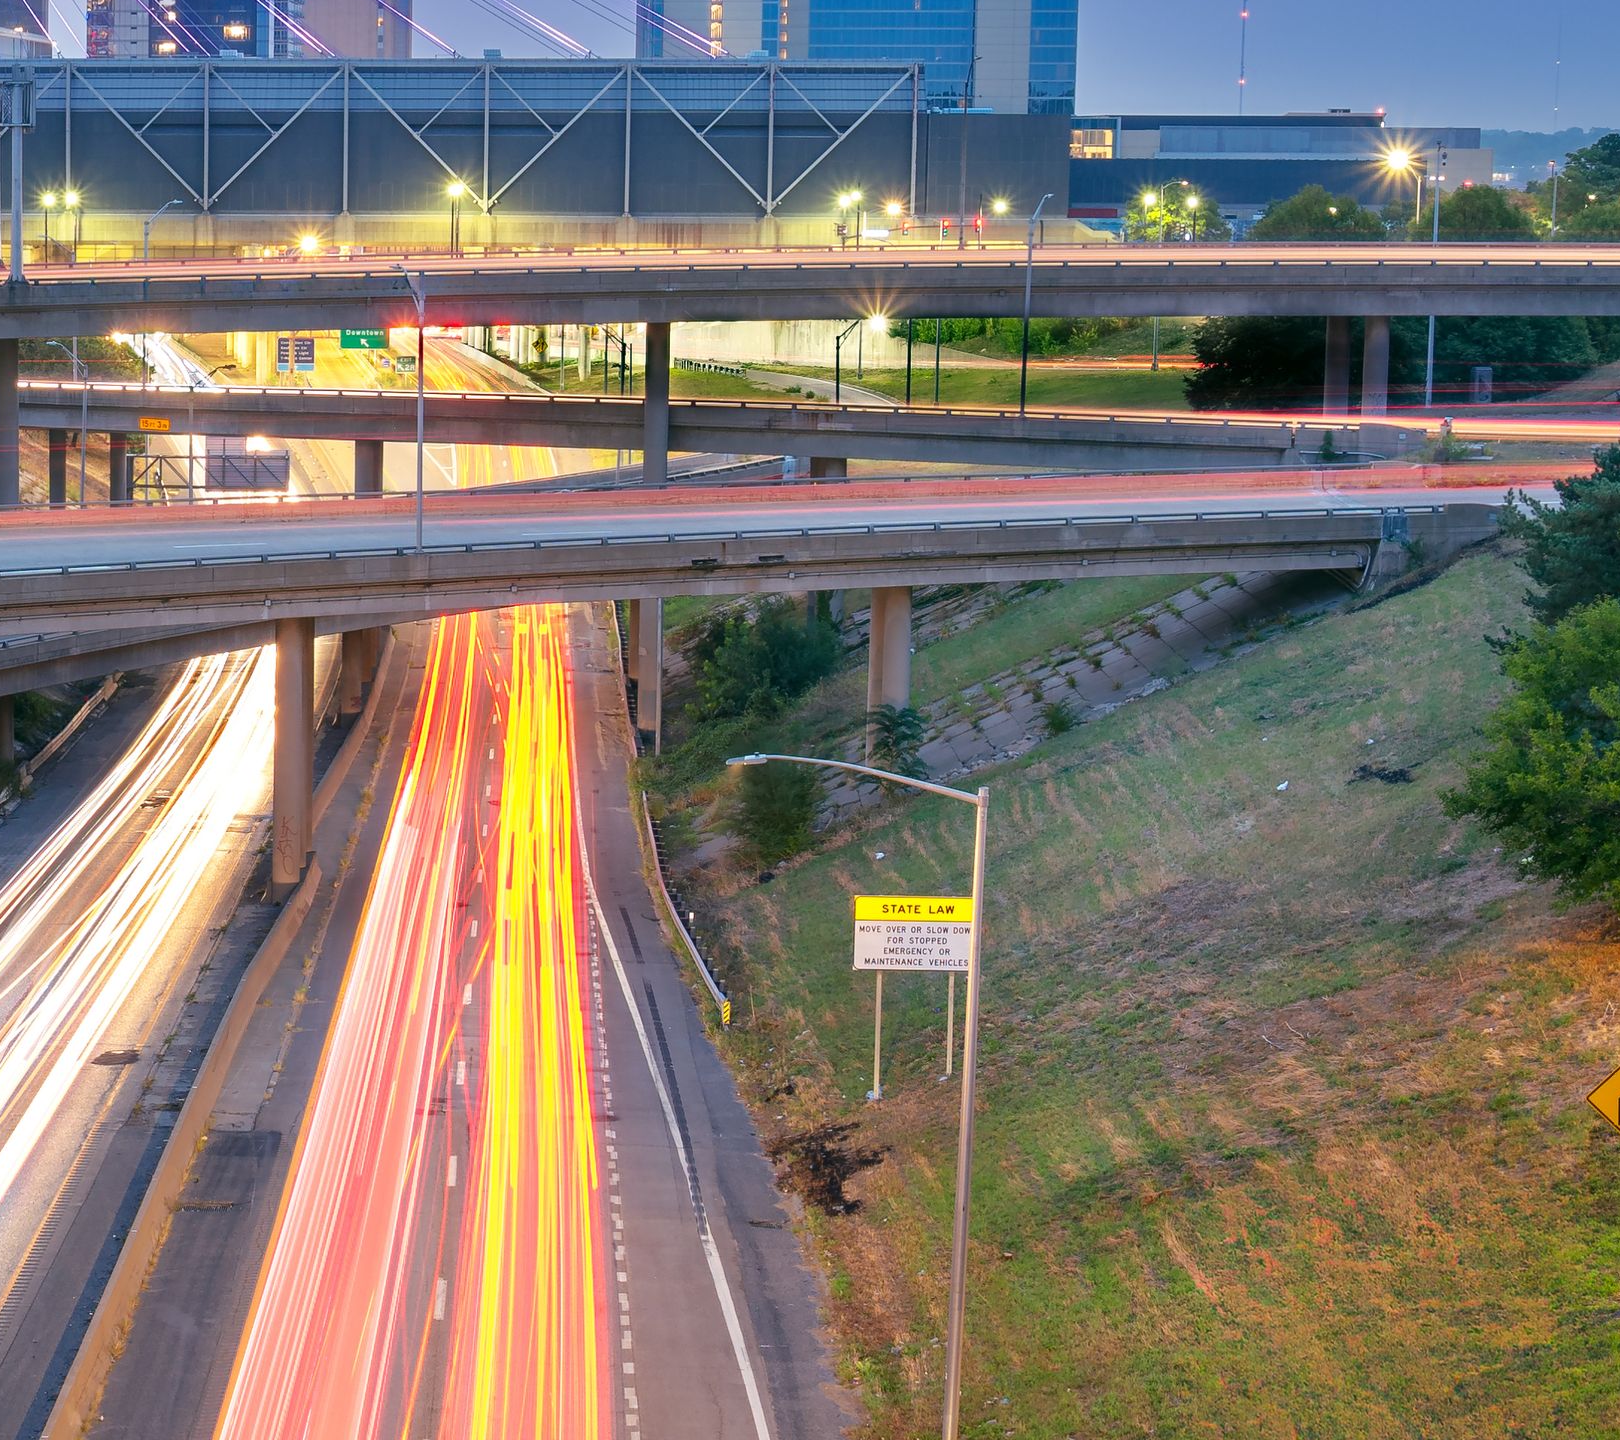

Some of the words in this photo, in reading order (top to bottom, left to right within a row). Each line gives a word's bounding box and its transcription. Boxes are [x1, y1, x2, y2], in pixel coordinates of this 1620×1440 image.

[142, 420, 149, 428] 15
[157, 421, 162, 429] 3
[882, 904, 921, 914] STATE
[928, 905, 955, 914] LAW
[859, 925, 881, 933] MOVE
[910, 926, 922, 934] OR
[926, 926, 949, 934] SLOW
[953, 926, 971, 934] DOW
[909, 937, 948, 945] STOPPED
[883, 947, 933, 955] EMERGENCY
[864, 958, 923, 966] MAINTENANCE
[929, 959, 969, 967] VEHICLES
